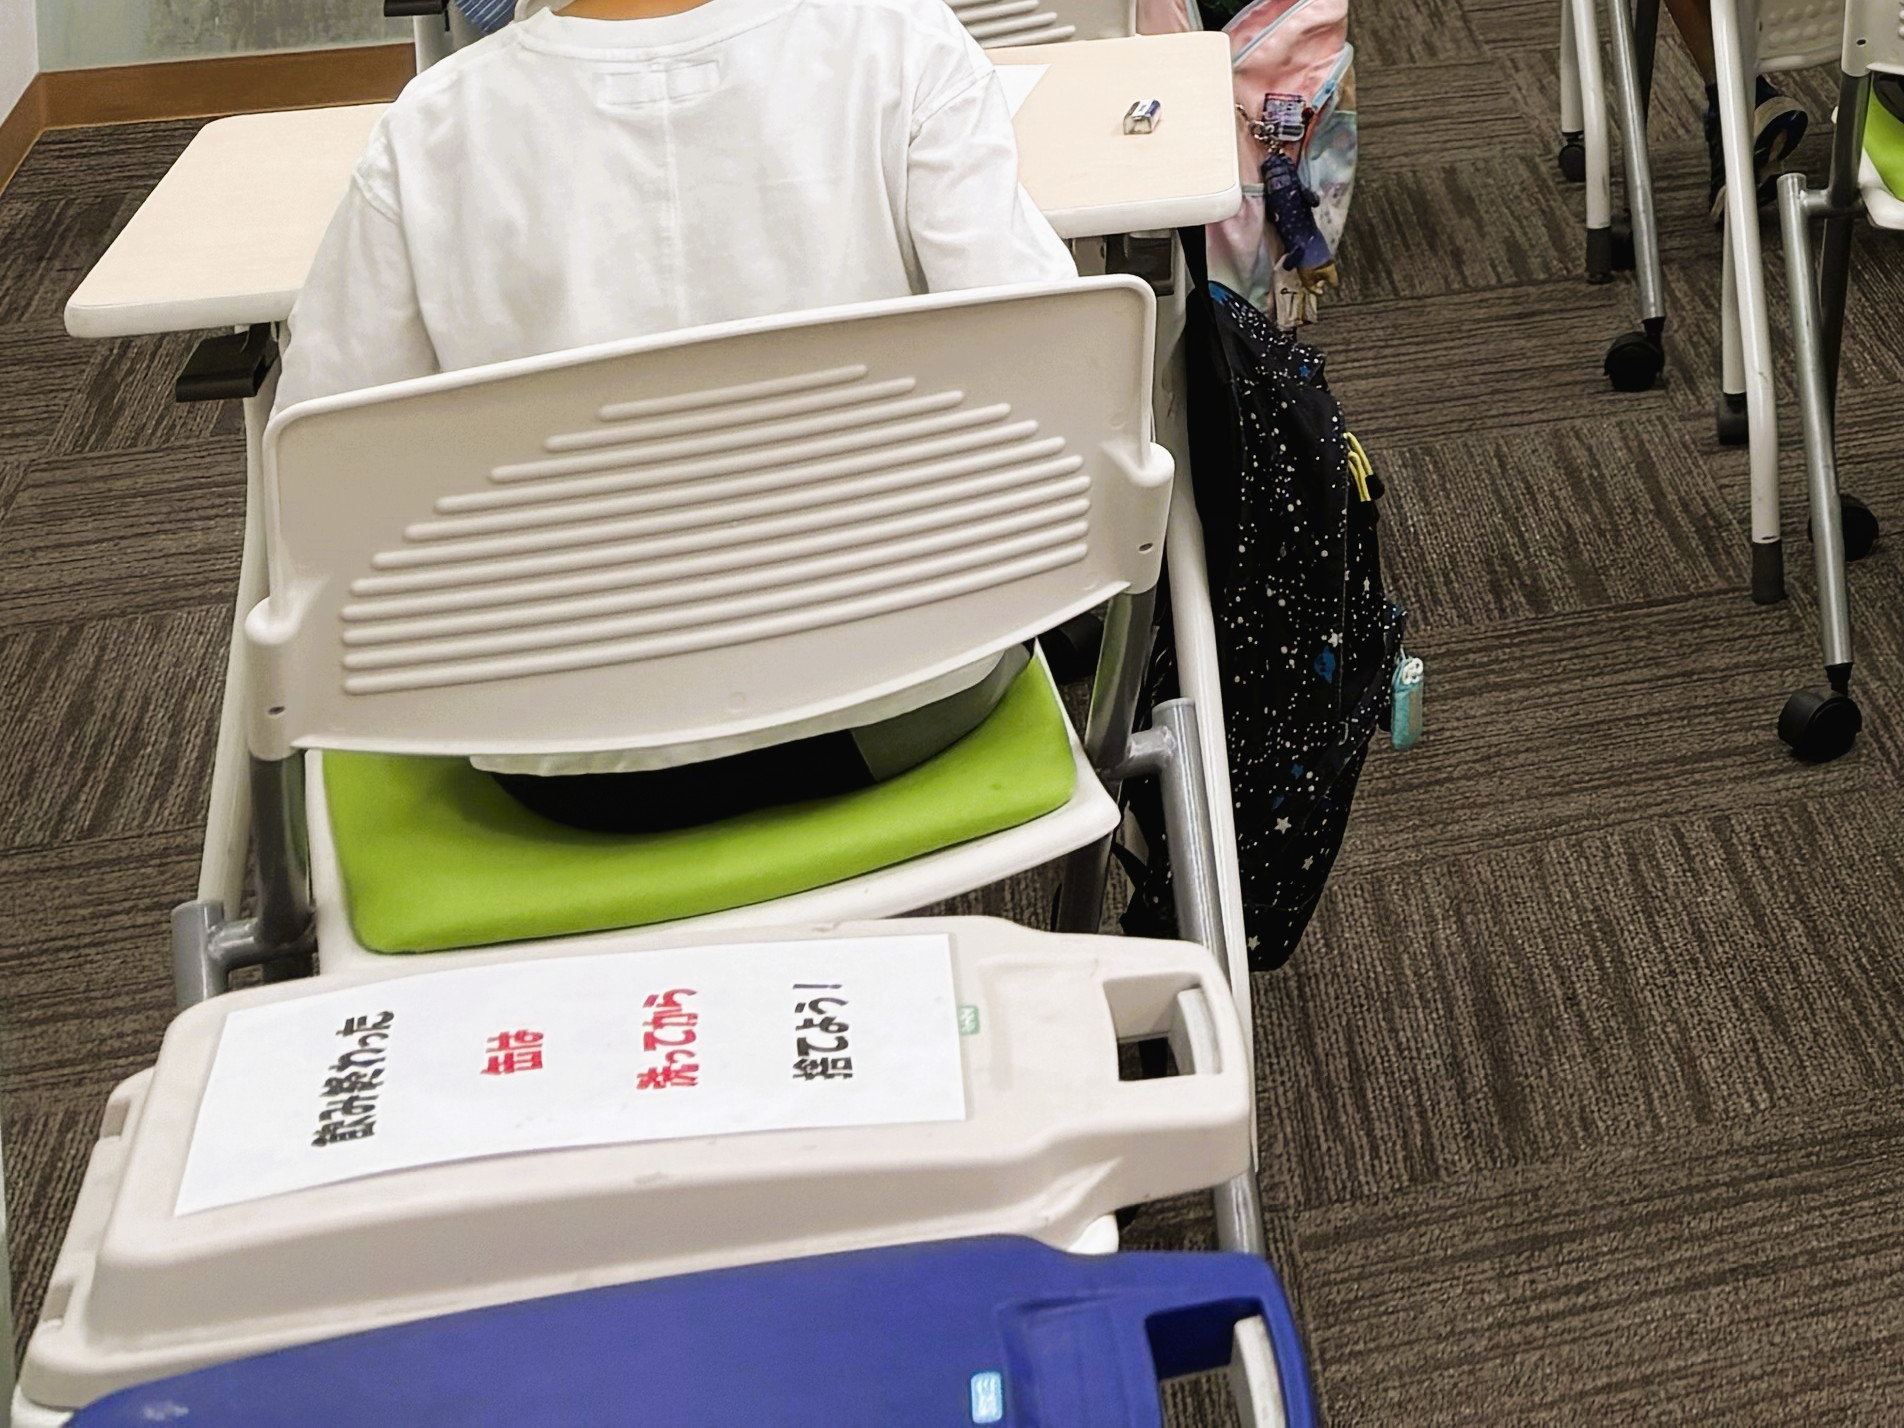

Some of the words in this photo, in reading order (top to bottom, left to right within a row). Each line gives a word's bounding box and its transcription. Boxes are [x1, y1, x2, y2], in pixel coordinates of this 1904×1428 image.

[314, 1010, 394, 1150] 飲み終わった
[481, 1030, 544, 1076] 缶は
[636, 988, 700, 1091] 洗ってから
[792, 982, 853, 1082] 捨てよう!
